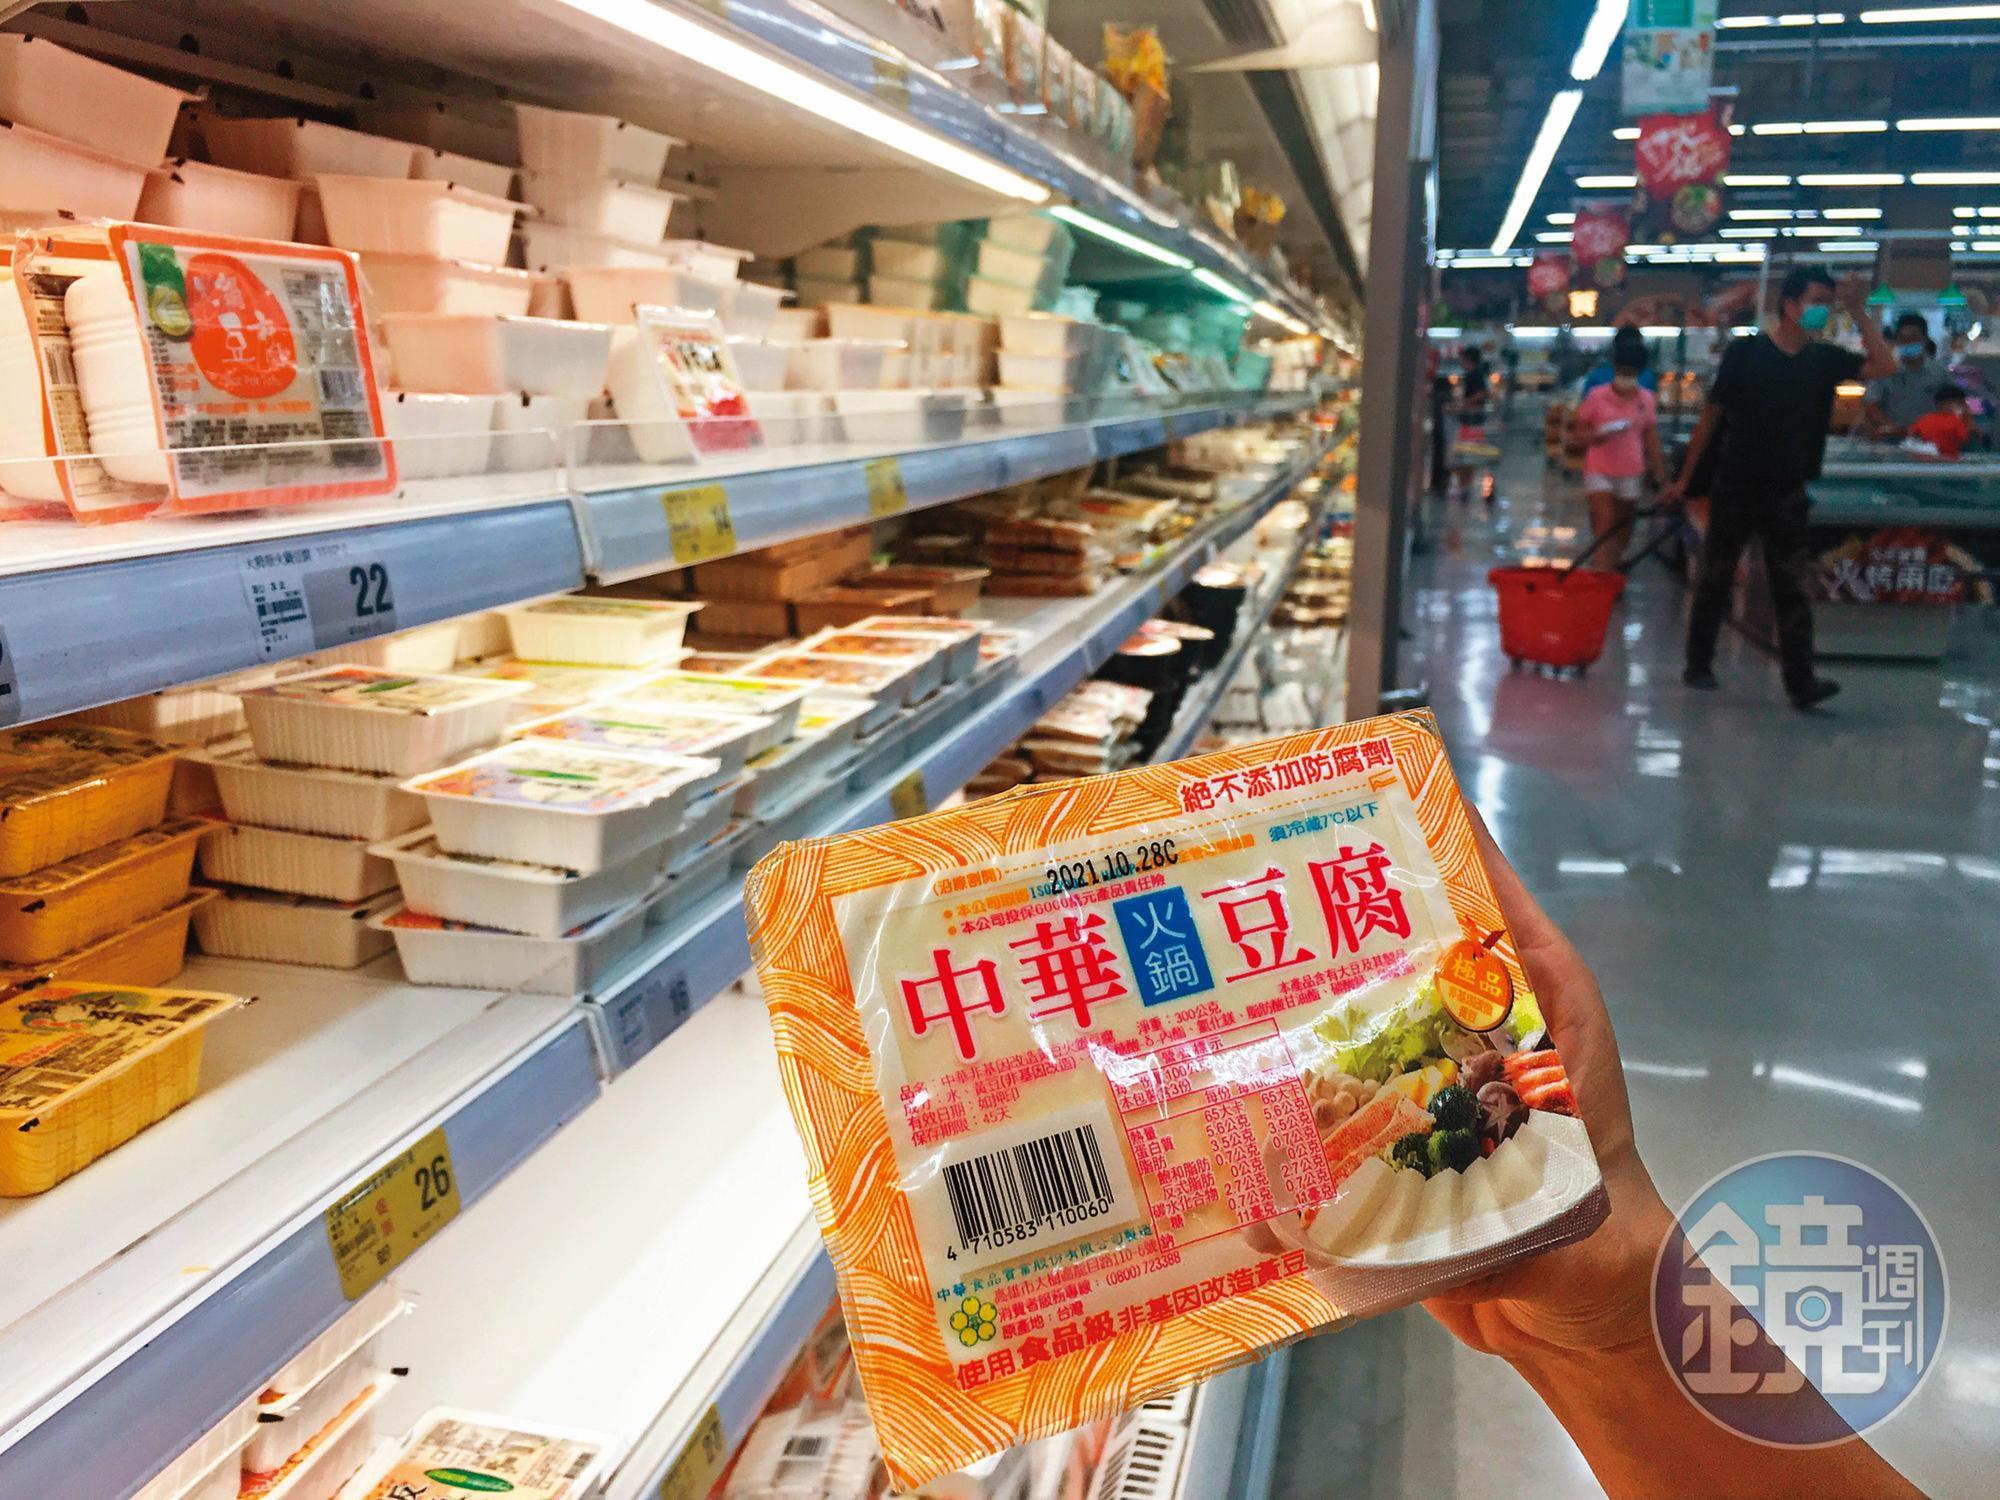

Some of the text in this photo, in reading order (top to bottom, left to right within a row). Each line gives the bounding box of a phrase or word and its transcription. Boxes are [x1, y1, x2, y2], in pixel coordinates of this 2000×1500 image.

[350, 562, 393, 617] 22
[1181, 738, 1394, 813] 絕不添加防腐劑
[1132, 900, 1198, 997] 火鍋
[1204, 1099, 1245, 1122] 65大卡
[1261, 1083, 1301, 1105] 65大卡
[1206, 1117, 1250, 1137] 5.6公克
[1264, 1098, 1307, 1120] 5.6公克
[1139, 1114, 1312, 1174] 脂肪 3.5公克 3.5公克
[1158, 1128, 1318, 1186] 飽和脂肪 0.7公克 0.7公克
[1162, 1142, 1321, 1201] 反式脂肪 0公克 0公克
[415, 1155, 450, 1211] 26
[1153, 1156, 1325, 1218] 碳水化合物 2.7公克 2.7公克
[1229, 1189, 1273, 1211] 0.7公克
[1286, 1172, 1330, 1193] 0.7公克
[947, 1197, 1110, 1261] 4 710583 110060
